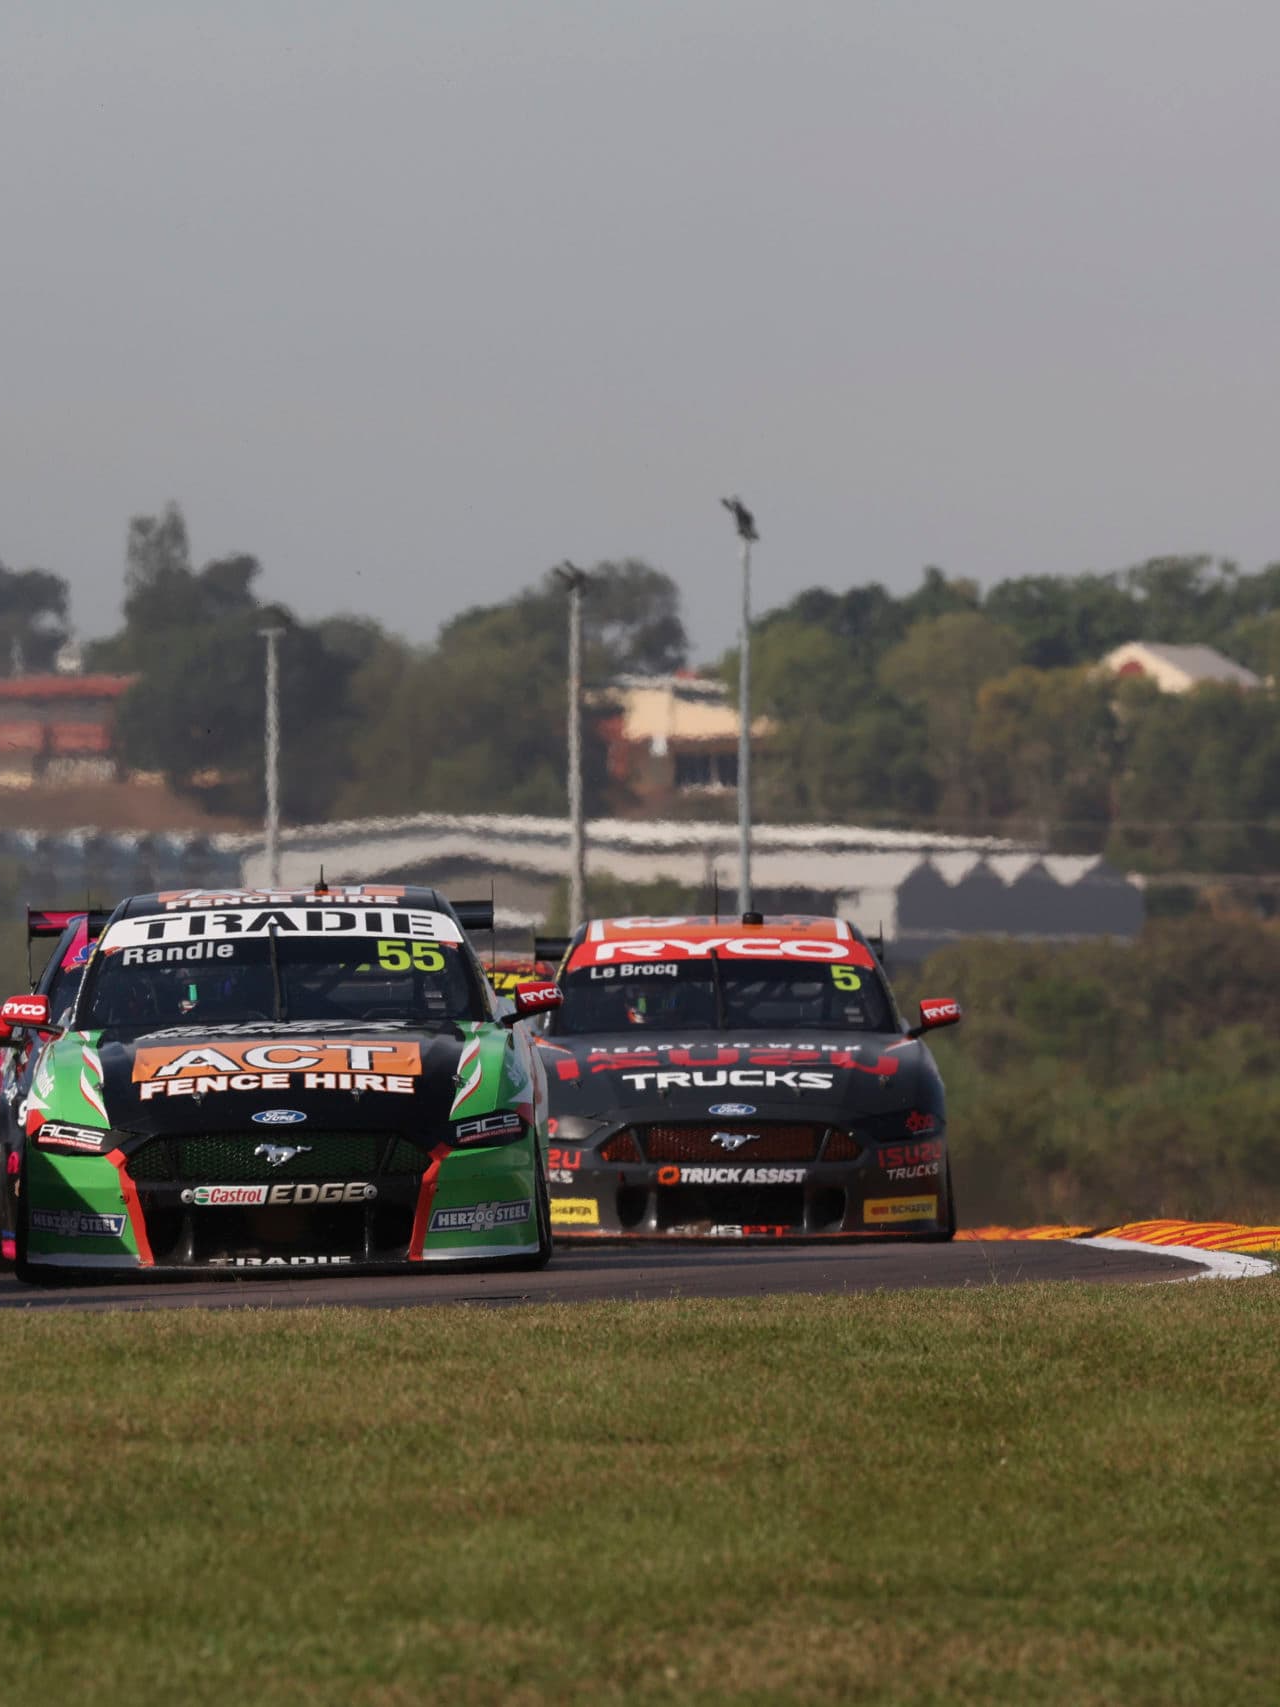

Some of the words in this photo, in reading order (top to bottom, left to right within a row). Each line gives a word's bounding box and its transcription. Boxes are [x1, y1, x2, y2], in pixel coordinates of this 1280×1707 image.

[166, 895, 292, 910] FENCE
[305, 895, 400, 904] HIRE
[133, 911, 435, 940] TRADIE
[122, 942, 234, 966] Randle
[377, 940, 446, 972] 55
[595, 938, 850, 960] RYCO
[590, 966, 615, 979] Le
[619, 964, 678, 977] Brocq
[830, 965, 862, 991] 5
[1, 1003, 47, 1016] RYCO
[153, 1045, 397, 1078] ACT
[139, 1073, 291, 1101] FENCE
[304, 1073, 416, 1095] HIRE
[622, 1070, 834, 1090] TRUCKS
[39, 1123, 105, 1145] ACS
[457, 1114, 520, 1137] ACS
[680, 1167, 744, 1184] TRUCK
[741, 1168, 808, 1184] ASSIST
[886, 1162, 939, 1181] TRUCKS
[210, 1188, 262, 1203] Castrol
[269, 1182, 370, 1204] EDGE
[33, 1213, 79, 1229] HERZOG
[80, 1218, 119, 1232] STEEL
[437, 1210, 495, 1227] HERZOG
[496, 1204, 527, 1221] STEEL
